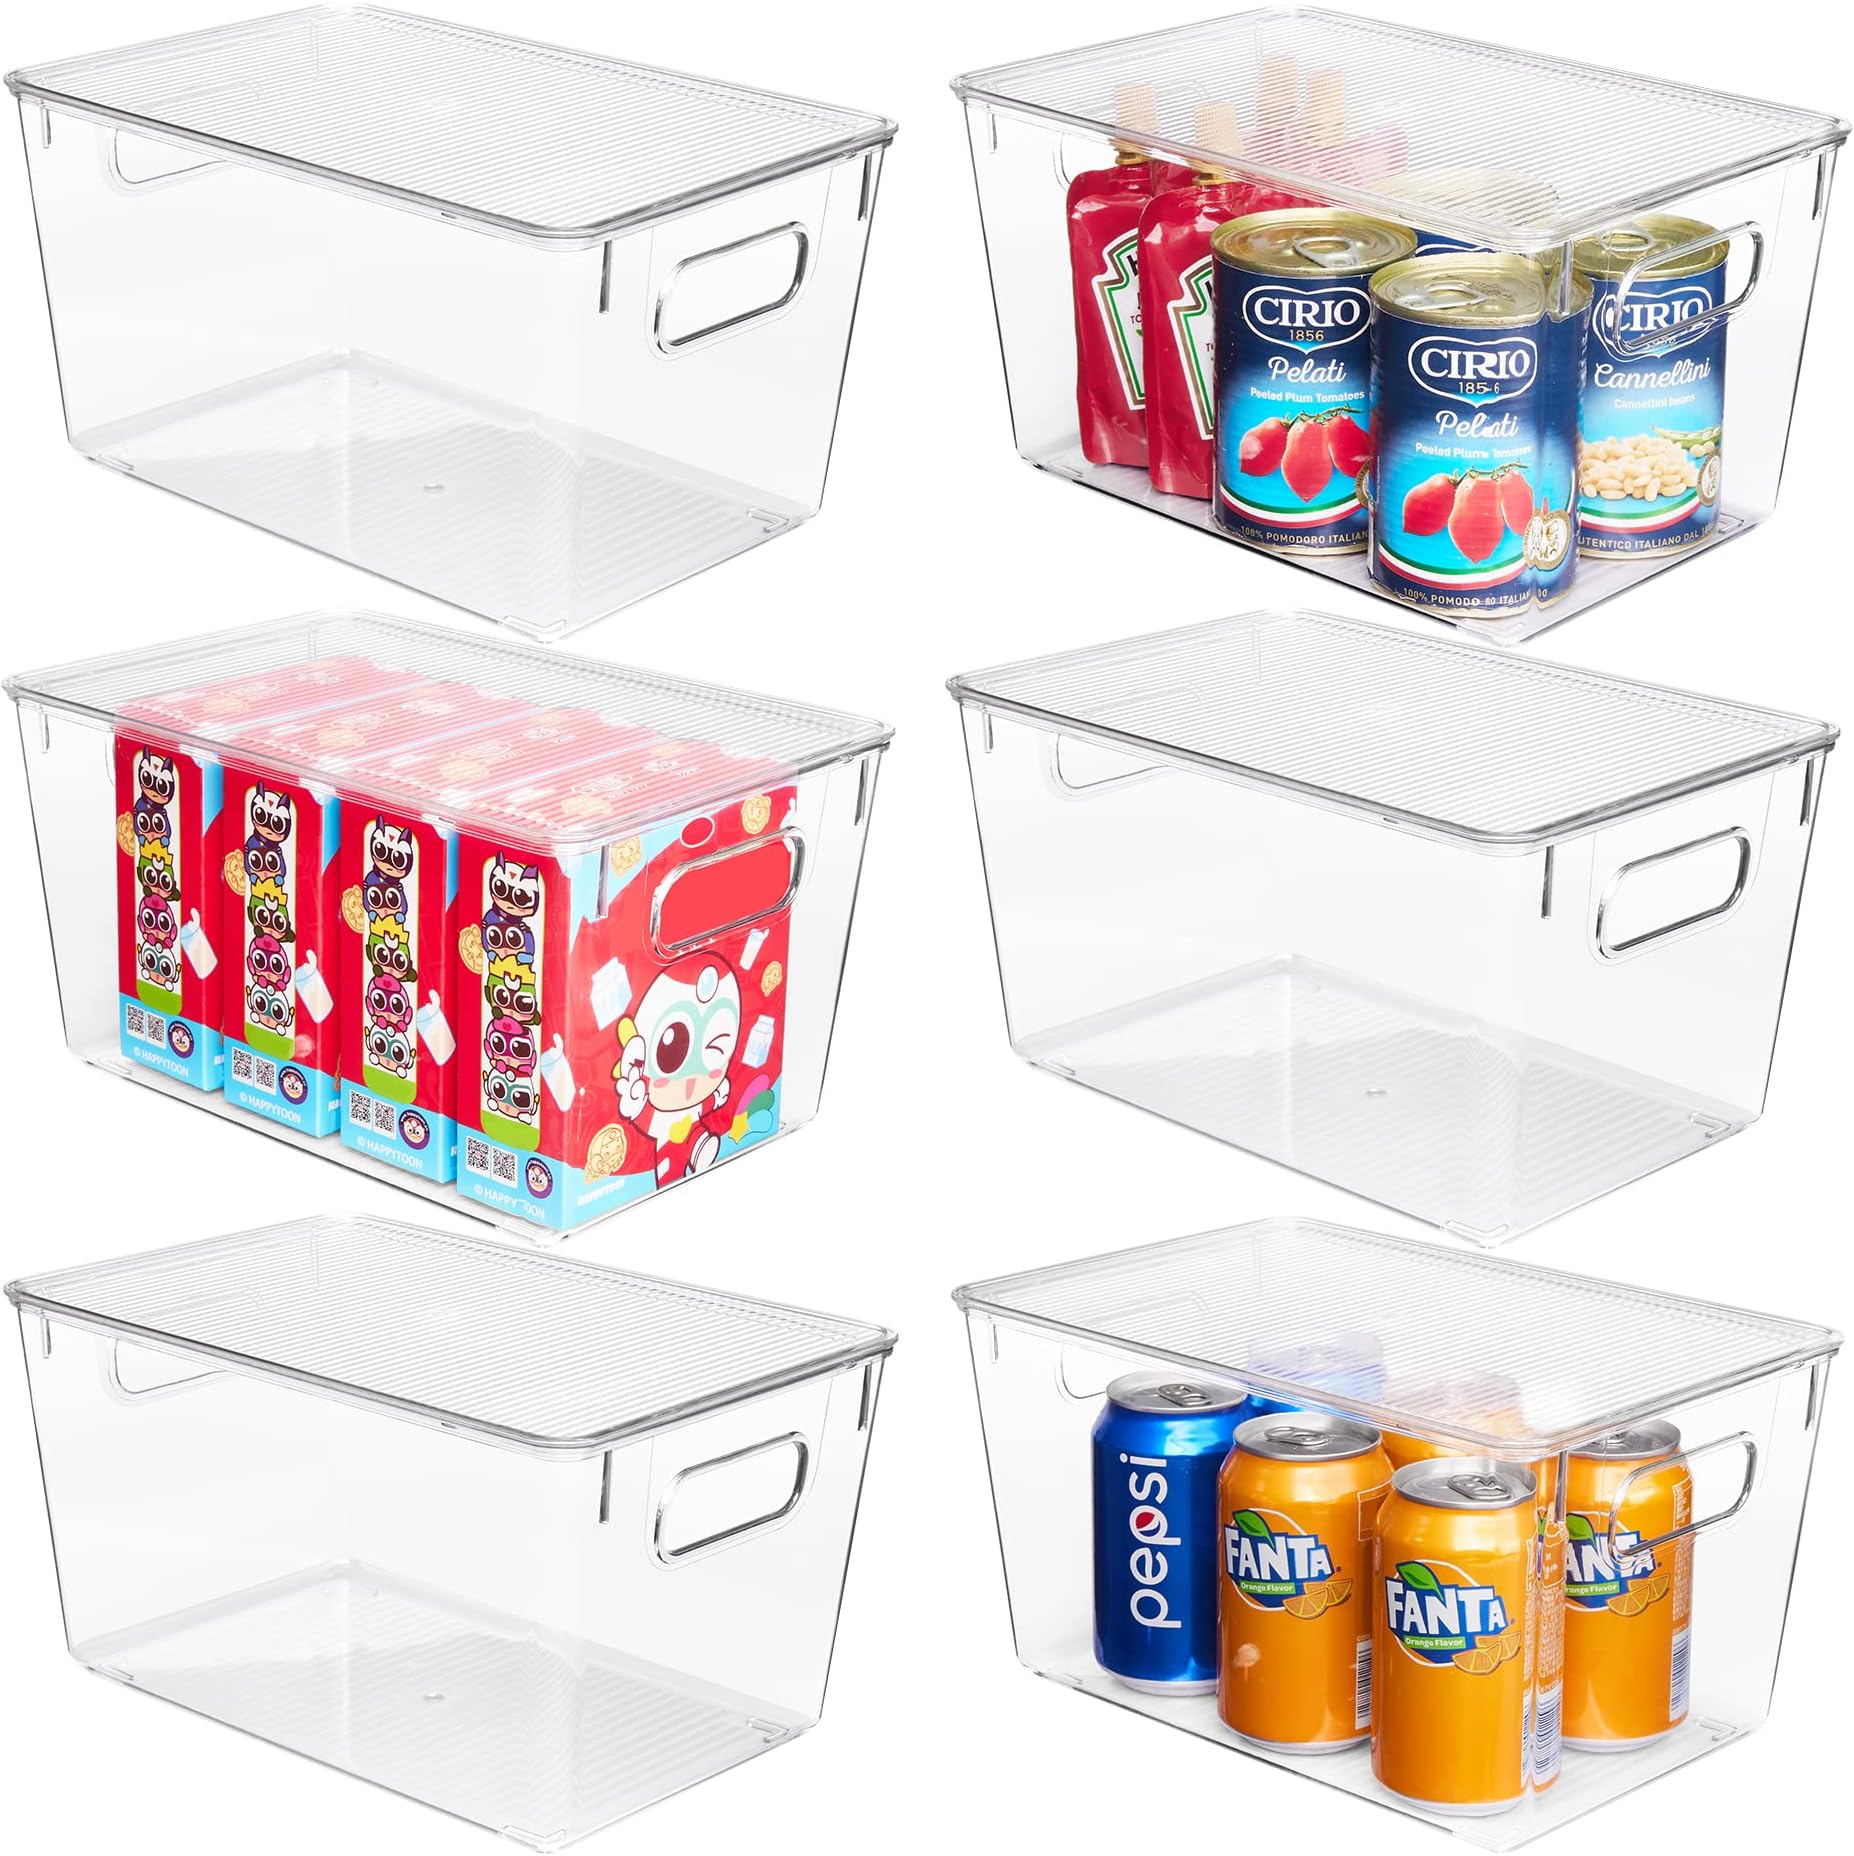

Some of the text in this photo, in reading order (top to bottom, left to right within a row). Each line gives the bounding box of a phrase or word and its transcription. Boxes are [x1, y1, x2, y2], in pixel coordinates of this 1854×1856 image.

[1254, 296, 1361, 328] CIRIO
[1605, 297, 1704, 331] CIRIO
[1290, 329, 1325, 342] 1856
[1268, 356, 1347, 383] Pelati
[1420, 347, 1531, 380] CIRIO
[1594, 357, 1711, 389] Cannellini
[1250, 386, 1365, 403] Peeled Plum Tomatoes
[1435, 410, 1519, 438] Pelati
[1415, 442, 1451, 457] Peeled
[1266, 531, 1326, 544] POMODORO
[1328, 529, 1369, 543] ITALIAN
[1578, 535, 1632, 549] UTENTICO
[1634, 535, 1682, 549] ITALIANO
[1683, 530, 1700, 542] DAL
[1403, 587, 1428, 601] 100%
[142, 1048, 190, 1077] HAPPYTOON
[248, 1094, 301, 1124] HAPPYTOON
[366, 1138, 423, 1170] HAPPYTOON
[1120, 1453, 1183, 1629] pepsi
[1224, 1526, 1332, 1581] FANTA
[1566, 1533, 1655, 1583] ANTA
[1240, 1582, 1293, 1593] Orange Flavor
[1566, 1584, 1617, 1596] range Flavor
[1385, 1578, 1507, 1635] FANTA
[1405, 1637, 1464, 1648] Orange Flavor
